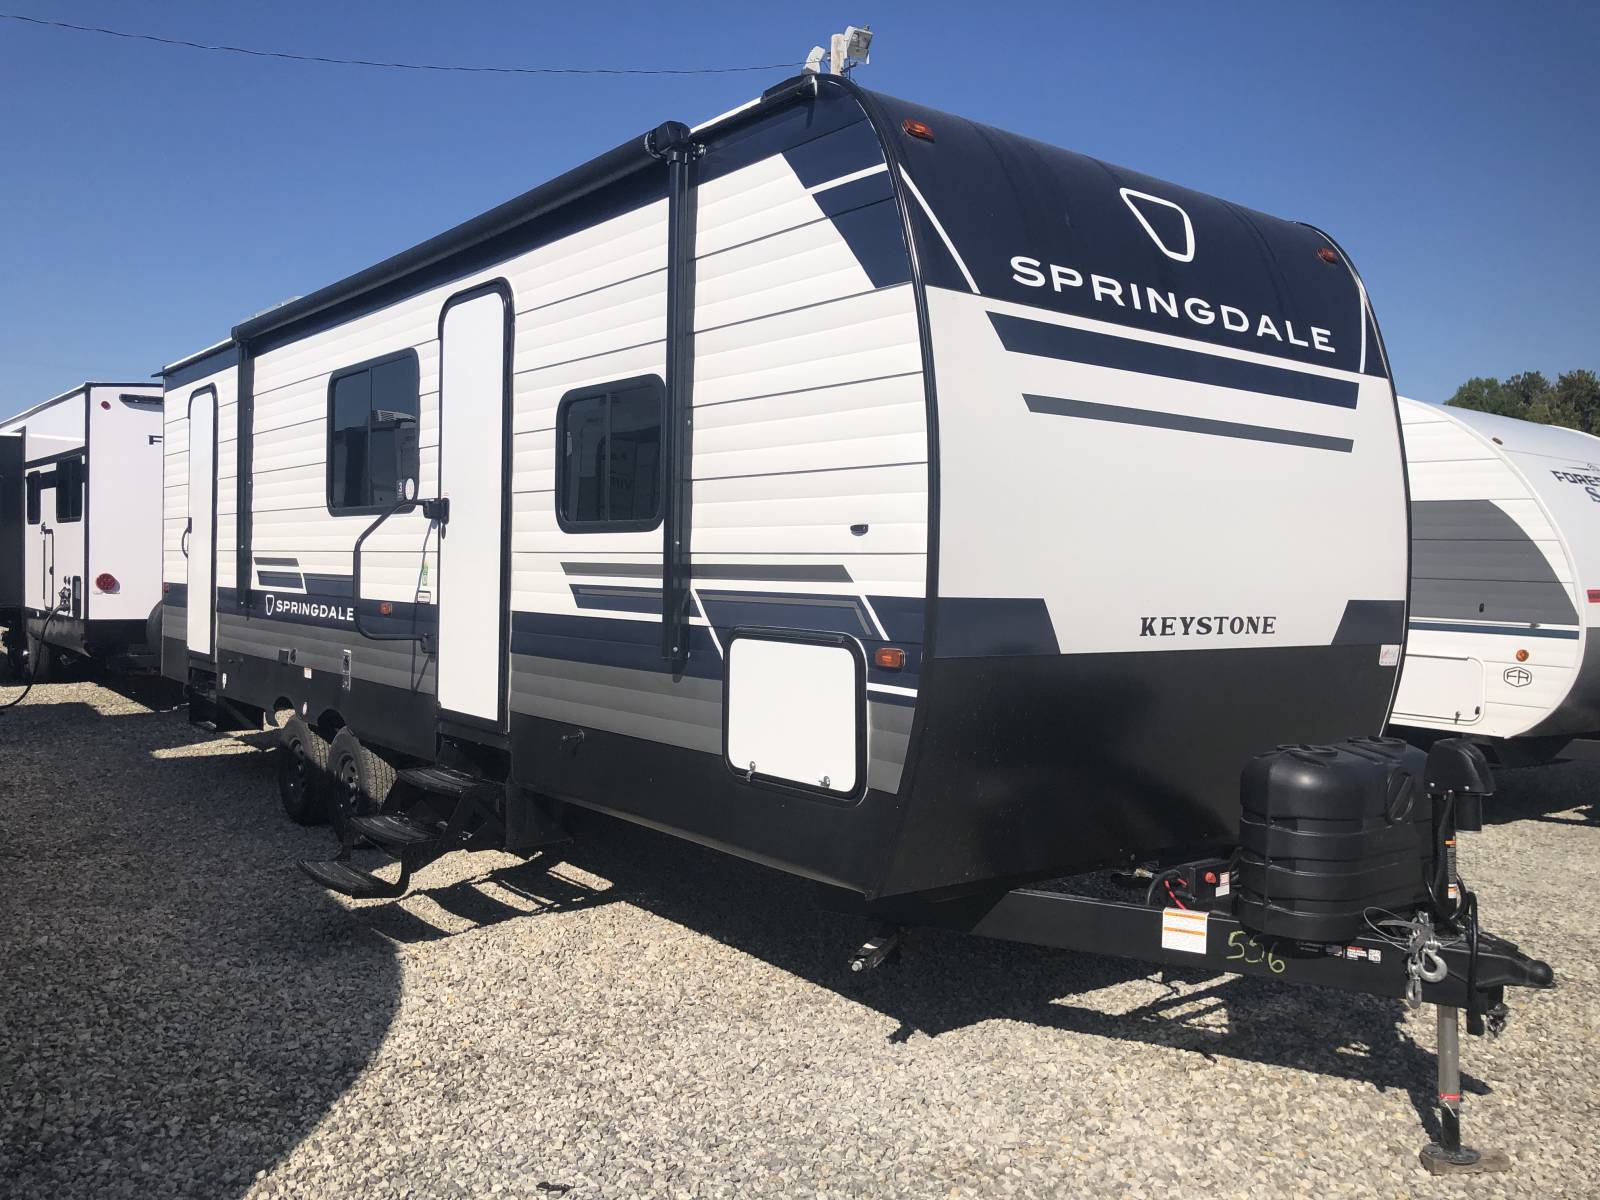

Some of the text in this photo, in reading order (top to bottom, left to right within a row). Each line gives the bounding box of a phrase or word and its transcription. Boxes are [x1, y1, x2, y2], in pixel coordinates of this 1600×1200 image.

[1010, 255, 1336, 353] SPRINGDALE
[276, 600, 355, 621] SPRINGDALE
[1139, 616, 1277, 637] KEYSTONE
